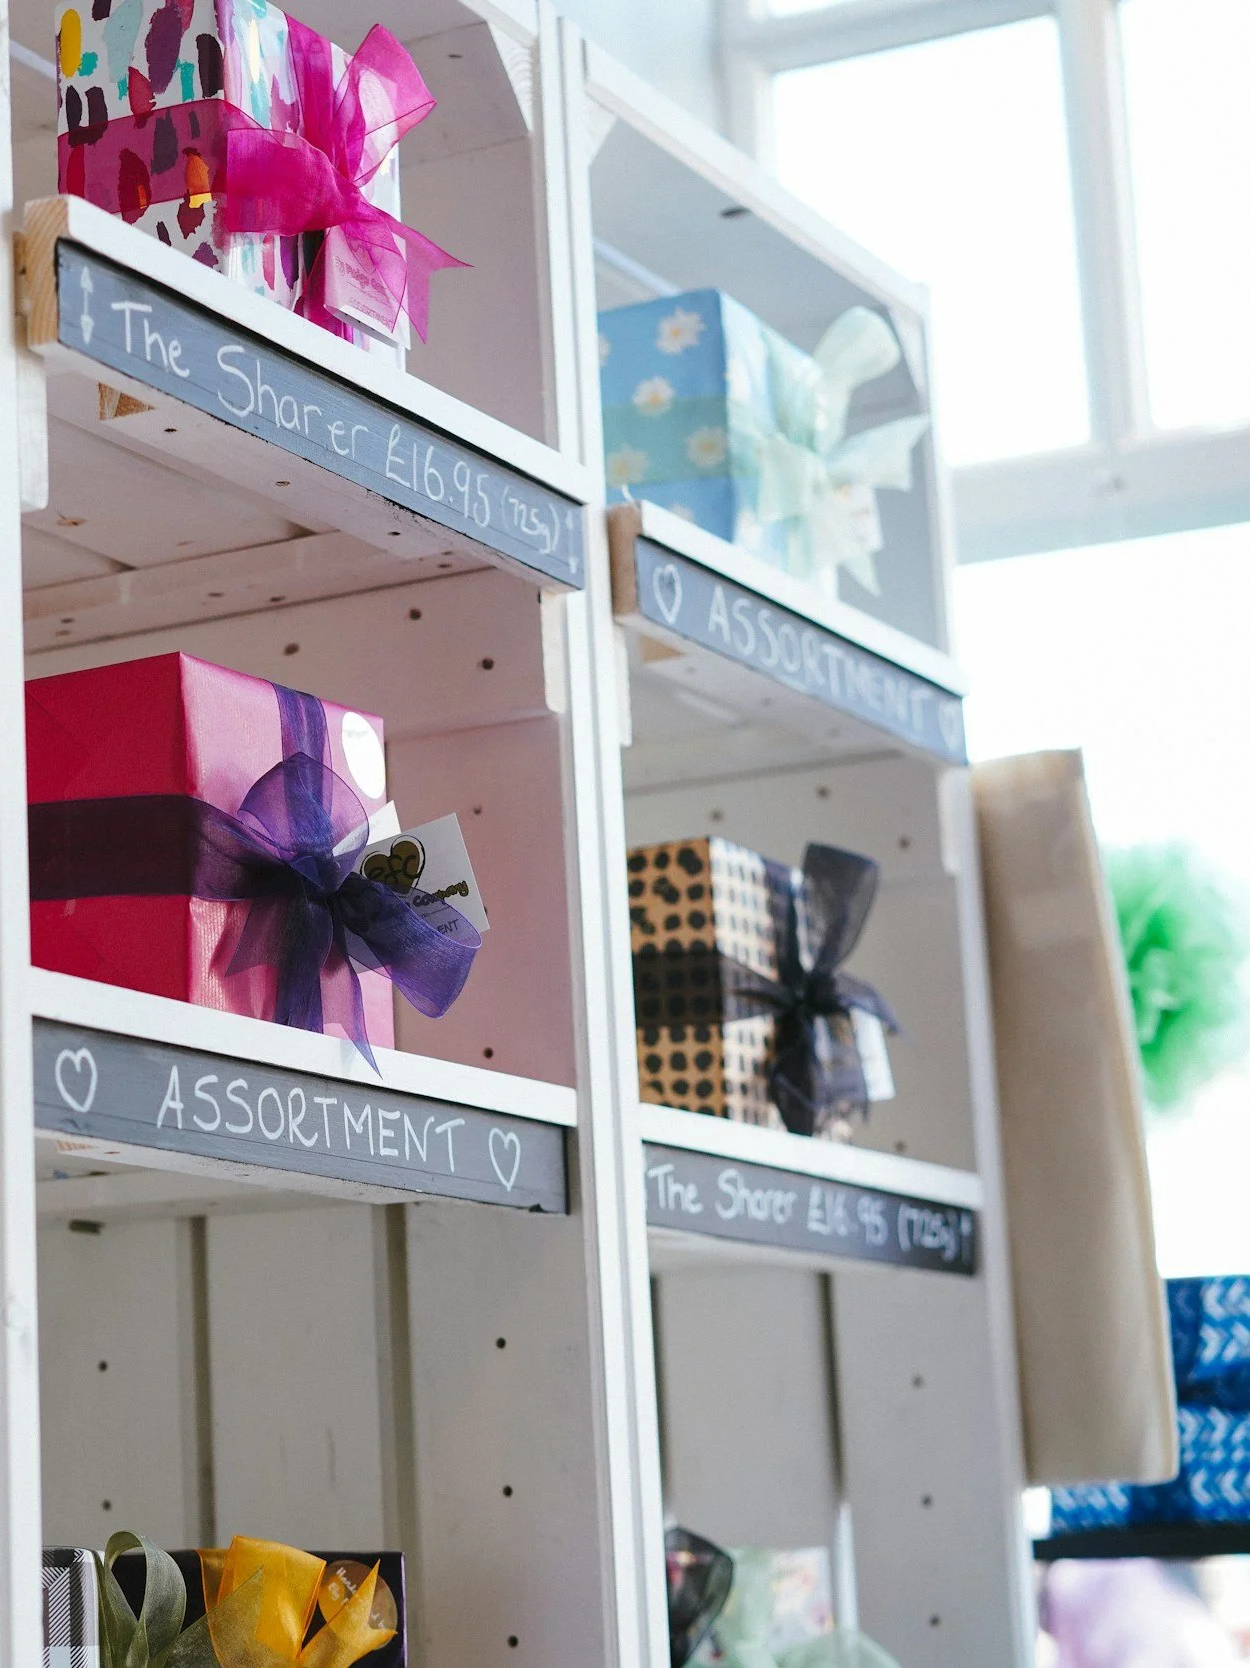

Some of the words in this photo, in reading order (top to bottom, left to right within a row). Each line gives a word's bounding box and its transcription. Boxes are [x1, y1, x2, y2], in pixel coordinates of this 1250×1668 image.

[110, 299, 190, 378] The
[216, 343, 370, 459] Sharer
[385, 423, 493, 529] £16.95
[501, 485, 559, 555] (725g)
[707, 584, 935, 733] ASSORTMENT
[156, 1064, 466, 1173] ASSORTMENT
[647, 1163, 704, 1214] The
[714, 1167, 799, 1224] Sharer
